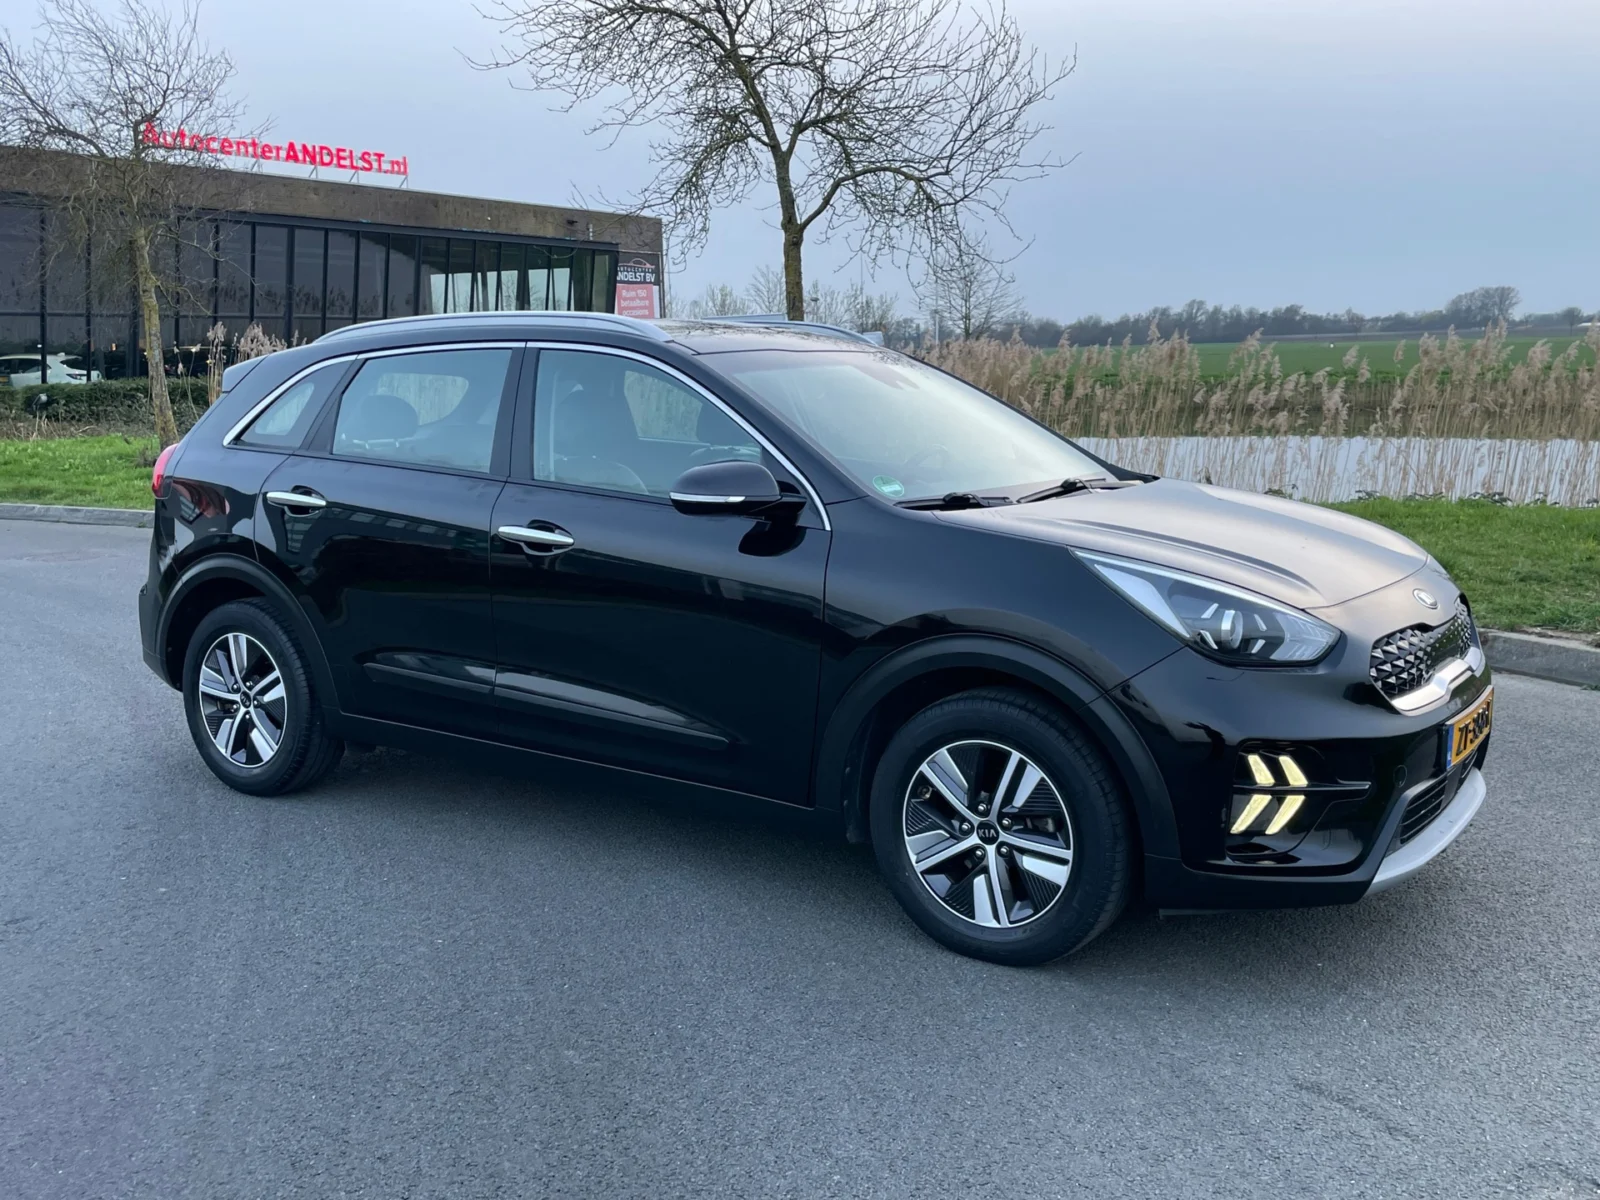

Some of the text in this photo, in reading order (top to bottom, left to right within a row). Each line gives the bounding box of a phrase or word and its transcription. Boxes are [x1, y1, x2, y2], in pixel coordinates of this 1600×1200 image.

[143, 121, 408, 176] AutocenterANDELST.nl
[646, 273, 655, 282] BV
[977, 828, 997, 838] KIA
